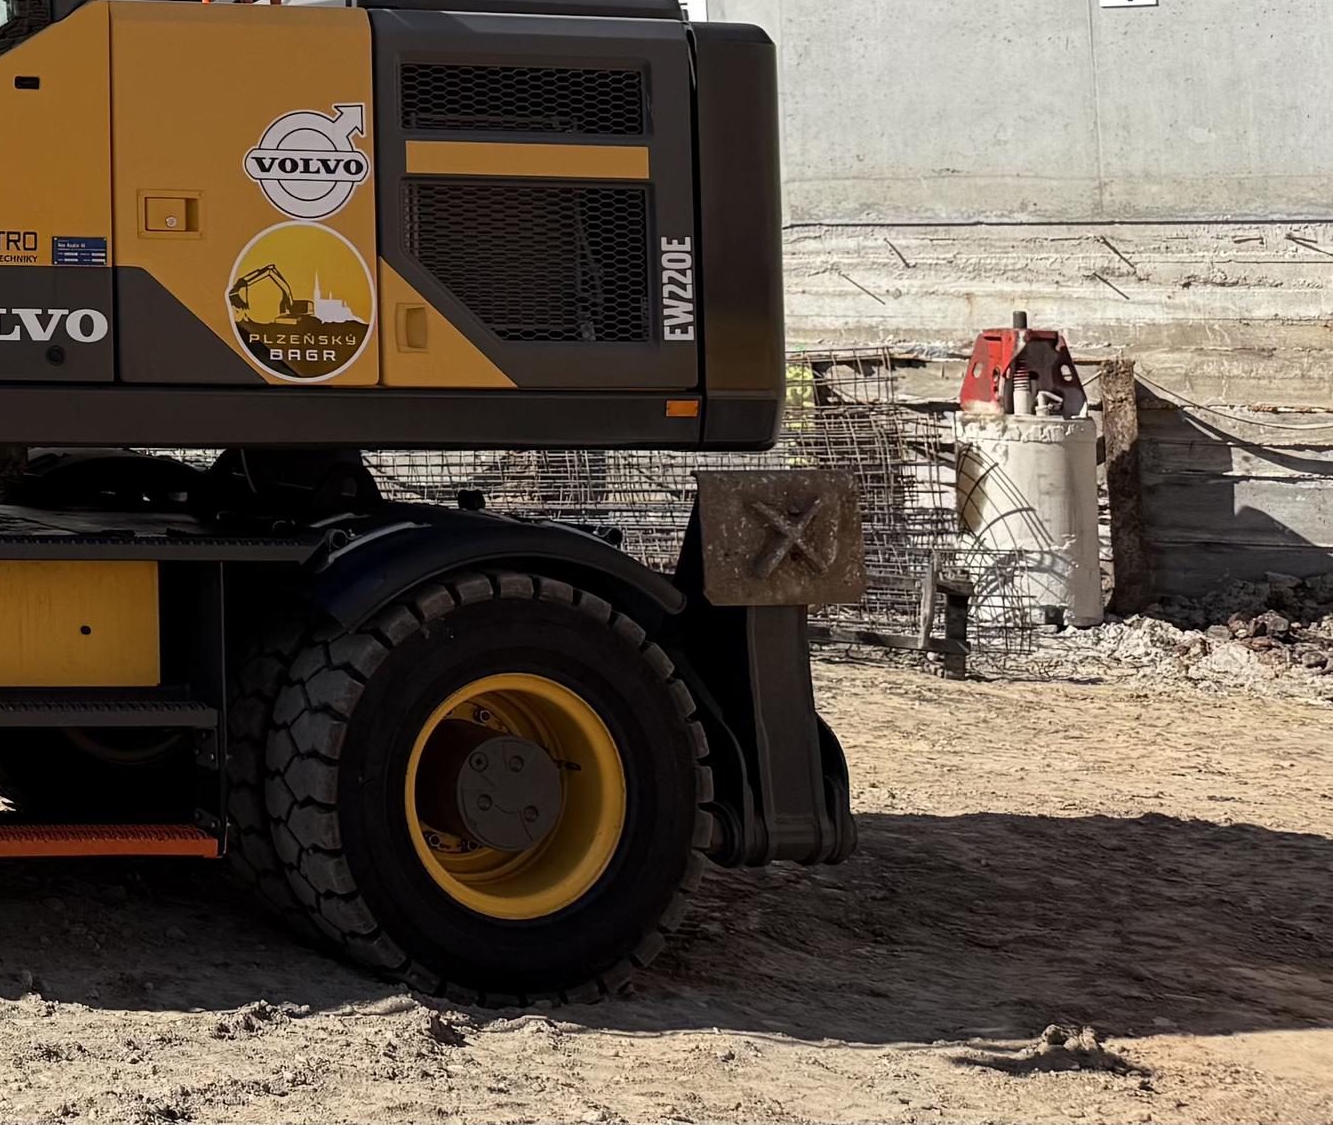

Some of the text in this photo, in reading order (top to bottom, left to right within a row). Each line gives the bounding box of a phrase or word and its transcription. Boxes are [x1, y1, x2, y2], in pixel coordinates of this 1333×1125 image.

[250, 156, 364, 175] VOLVO
[661, 236, 694, 341] EW220E
[249, 333, 356, 345] PLZEŇSKÝ
[270, 348, 336, 361] BAGR
